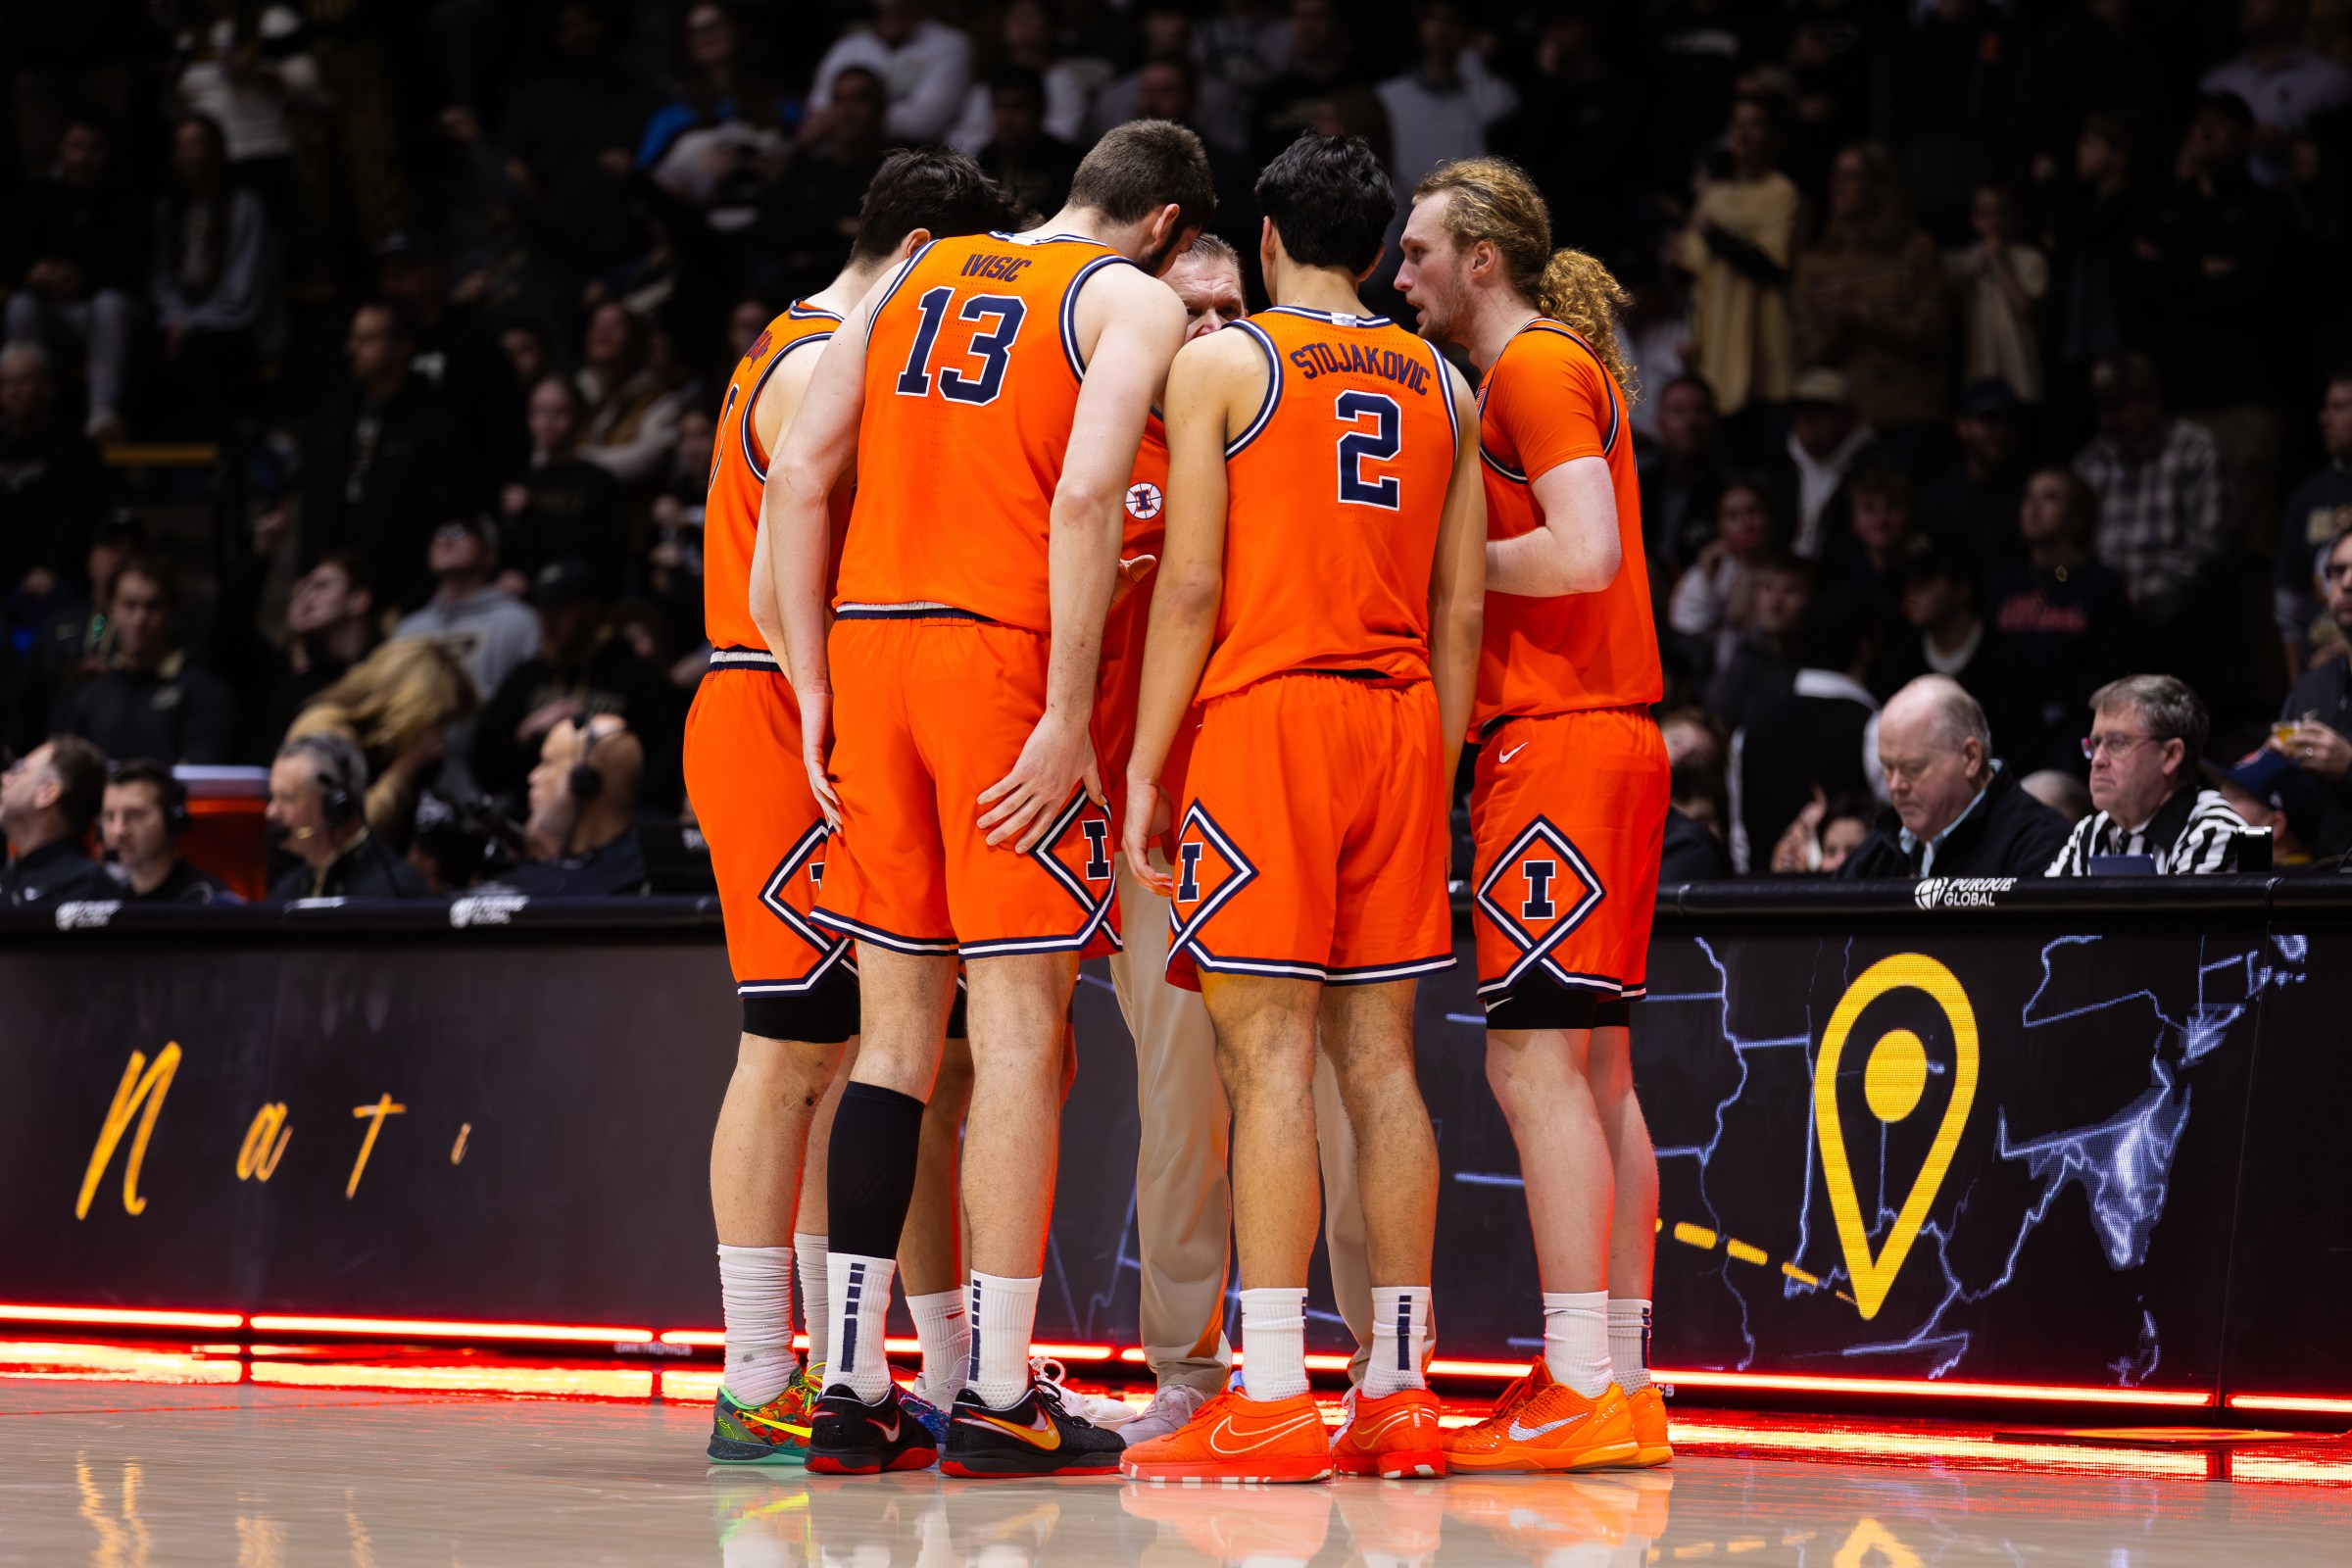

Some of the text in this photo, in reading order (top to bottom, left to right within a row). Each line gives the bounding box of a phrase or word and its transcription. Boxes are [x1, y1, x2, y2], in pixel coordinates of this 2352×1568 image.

[960, 254, 1032, 282] IVISIC
[896, 286, 1027, 407] 13
[1290, 342, 1431, 396] STOJAKOVIC
[1335, 389, 1401, 512] 2
[1081, 819, 1111, 880] I
[1177, 842, 1203, 903] I
[1522, 860, 1555, 919] I
[1943, 892, 1995, 906] GLOBAL
[1947, 877, 2018, 892] PURDUE
